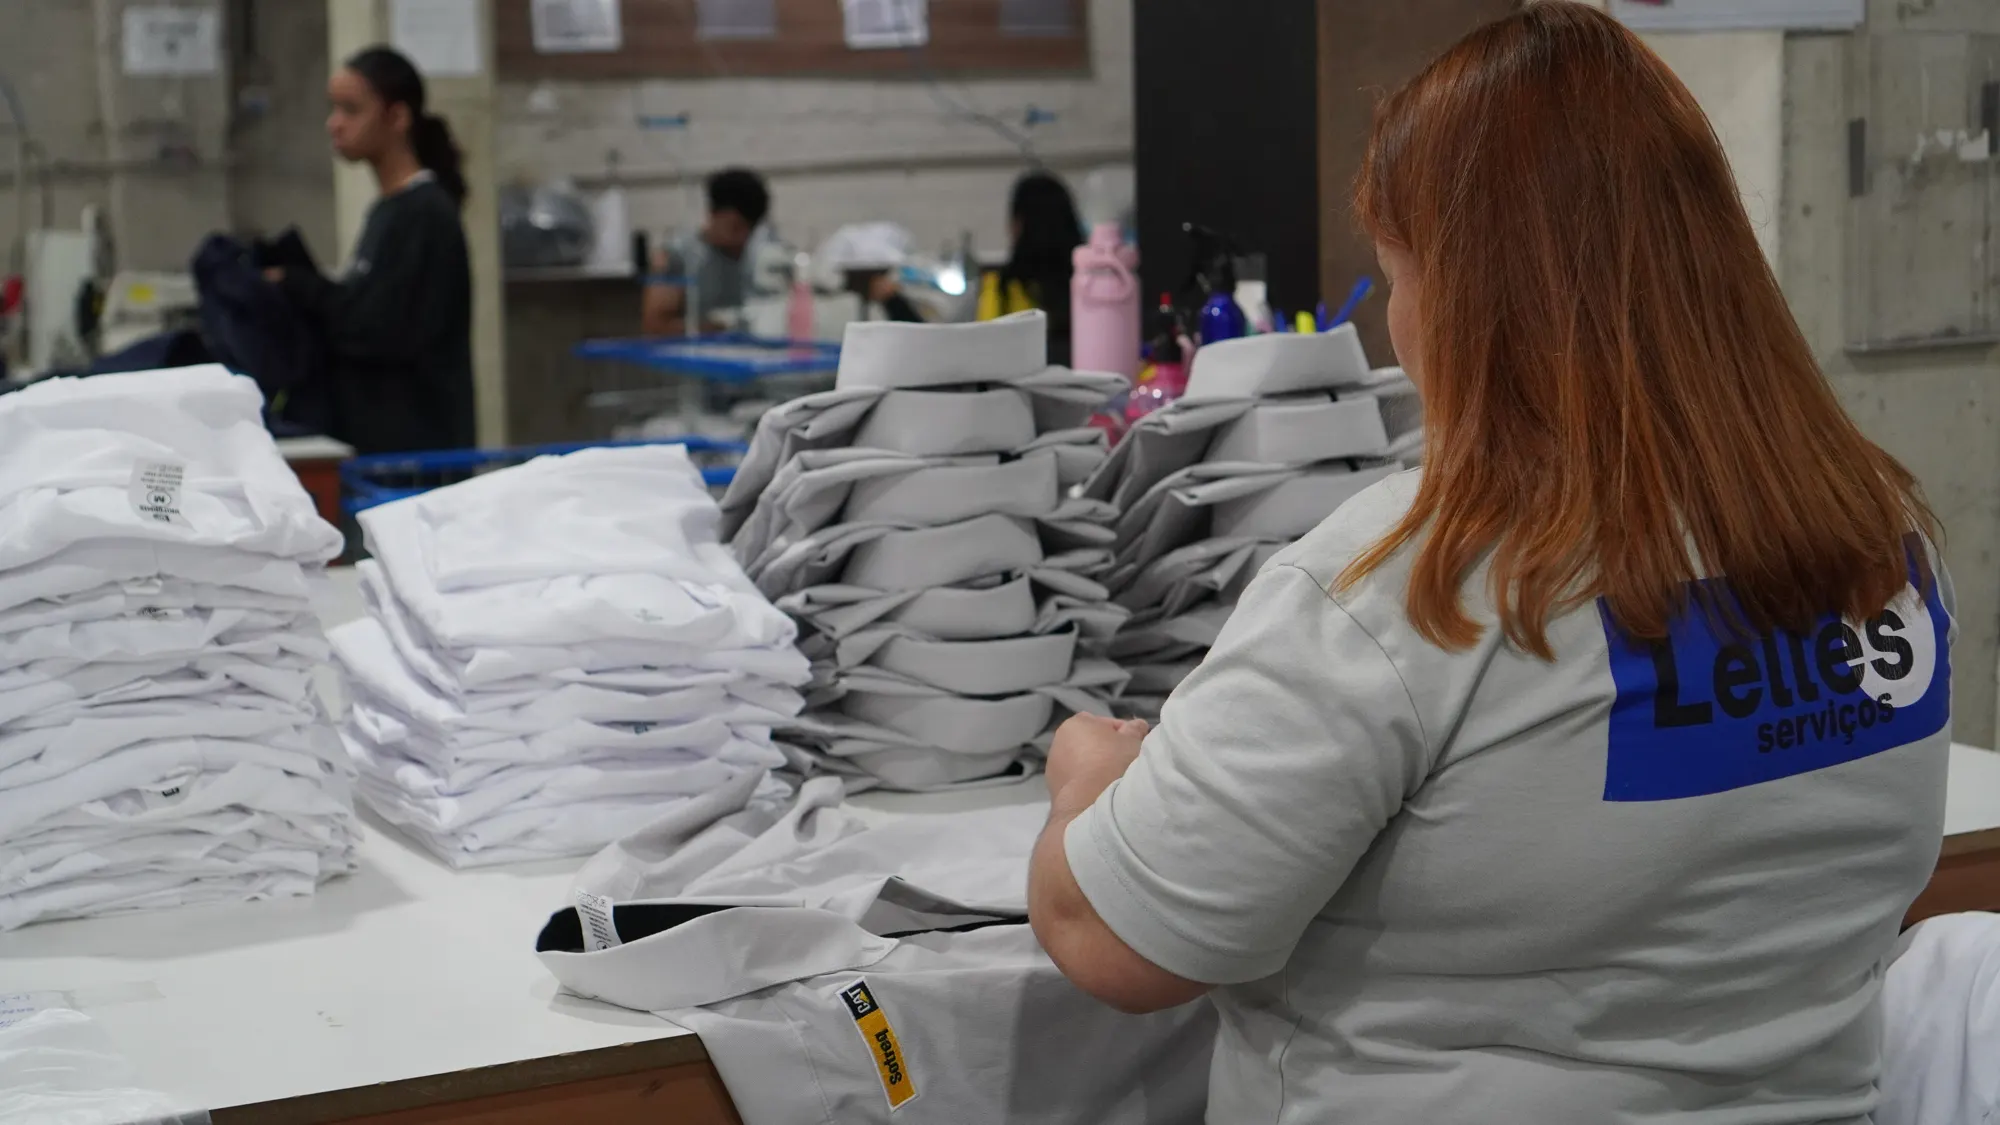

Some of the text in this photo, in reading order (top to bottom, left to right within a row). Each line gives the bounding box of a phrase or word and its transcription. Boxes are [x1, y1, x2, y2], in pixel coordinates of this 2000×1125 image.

[1757, 692, 1895, 753] serviços
[846, 987, 871, 1014] CAT
[874, 1028, 903, 1085] Sotreq
